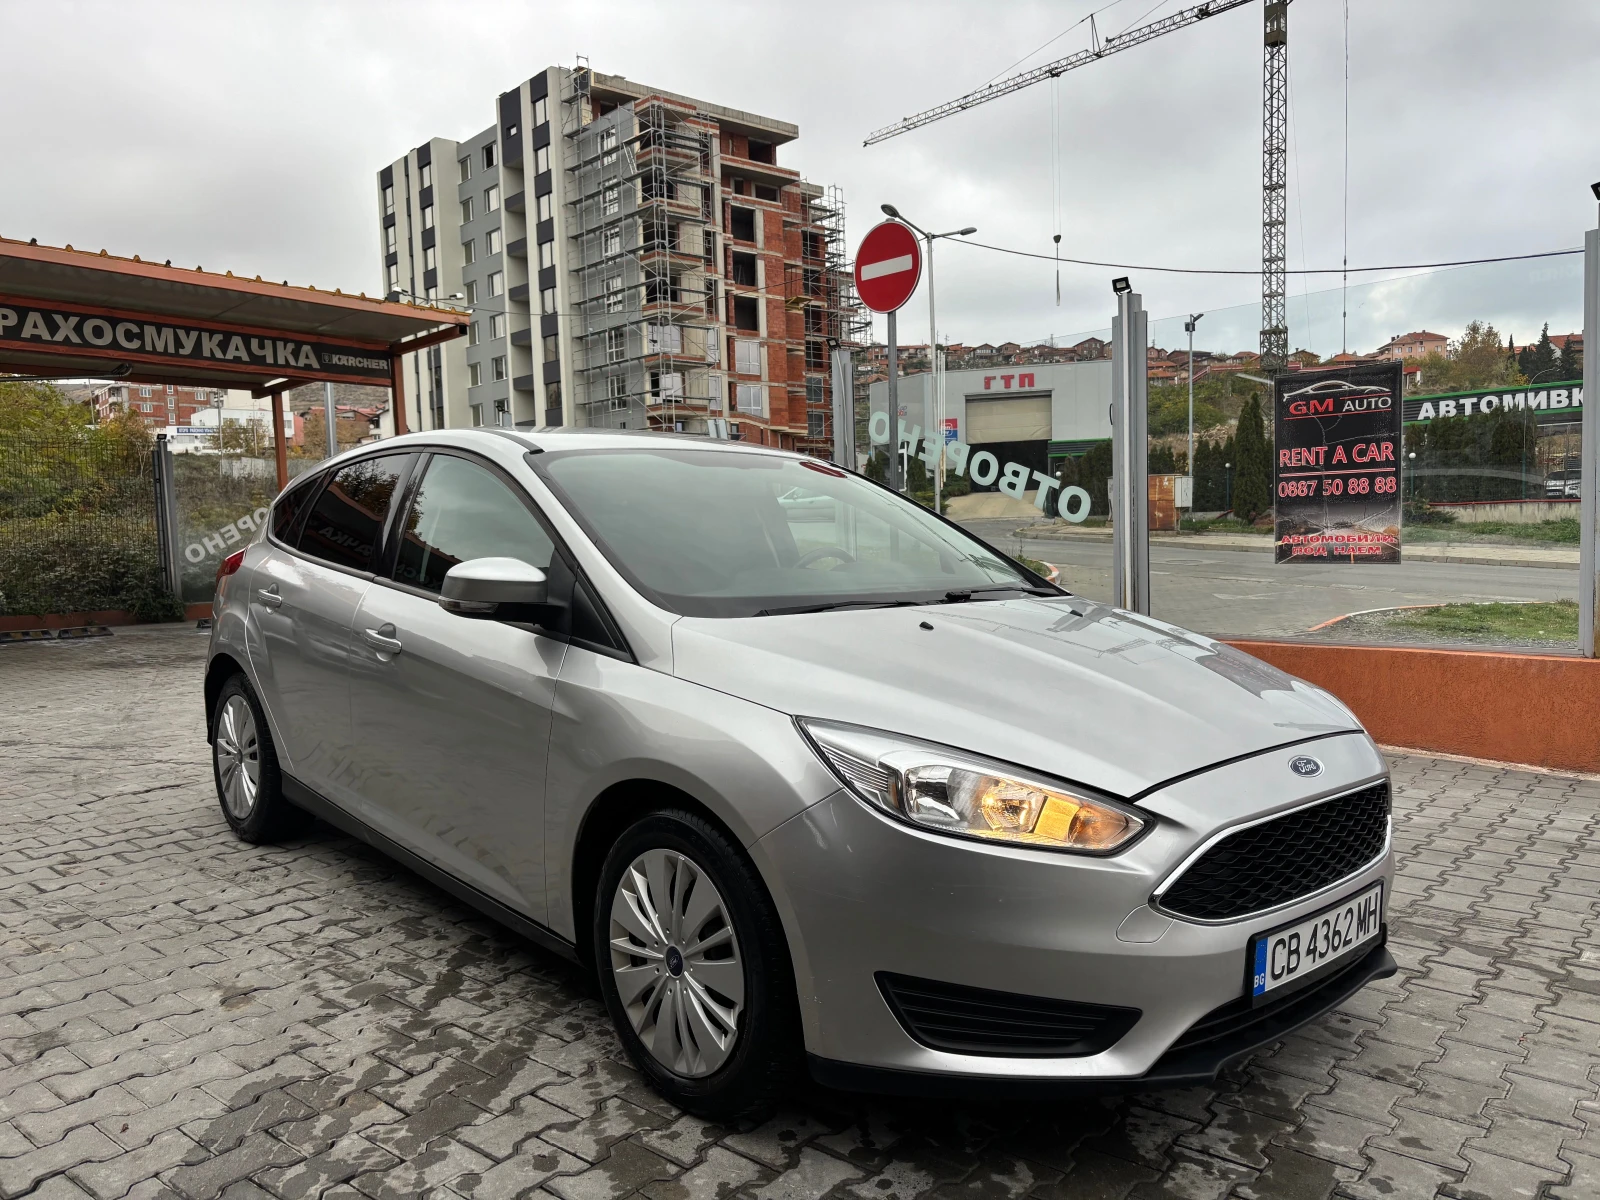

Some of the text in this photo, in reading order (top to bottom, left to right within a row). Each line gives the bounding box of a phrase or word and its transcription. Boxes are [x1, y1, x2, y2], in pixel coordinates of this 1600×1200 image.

[984, 373, 1035, 390] ГТП
[1289, 396, 1392, 415] GM AUTO
[1279, 441, 1395, 468] RENT A CAR
[1278, 476, 1397, 498] 0887 50 88 88
[1281, 533, 1397, 544] АВТОМОБИЛИ
[1292, 545, 1383, 556] ПОД НАЕМ
[1296, 759, 1317, 773] Ford
[1270, 891, 1379, 981] CB 4362 MH
[1253, 973, 1265, 989] BG
